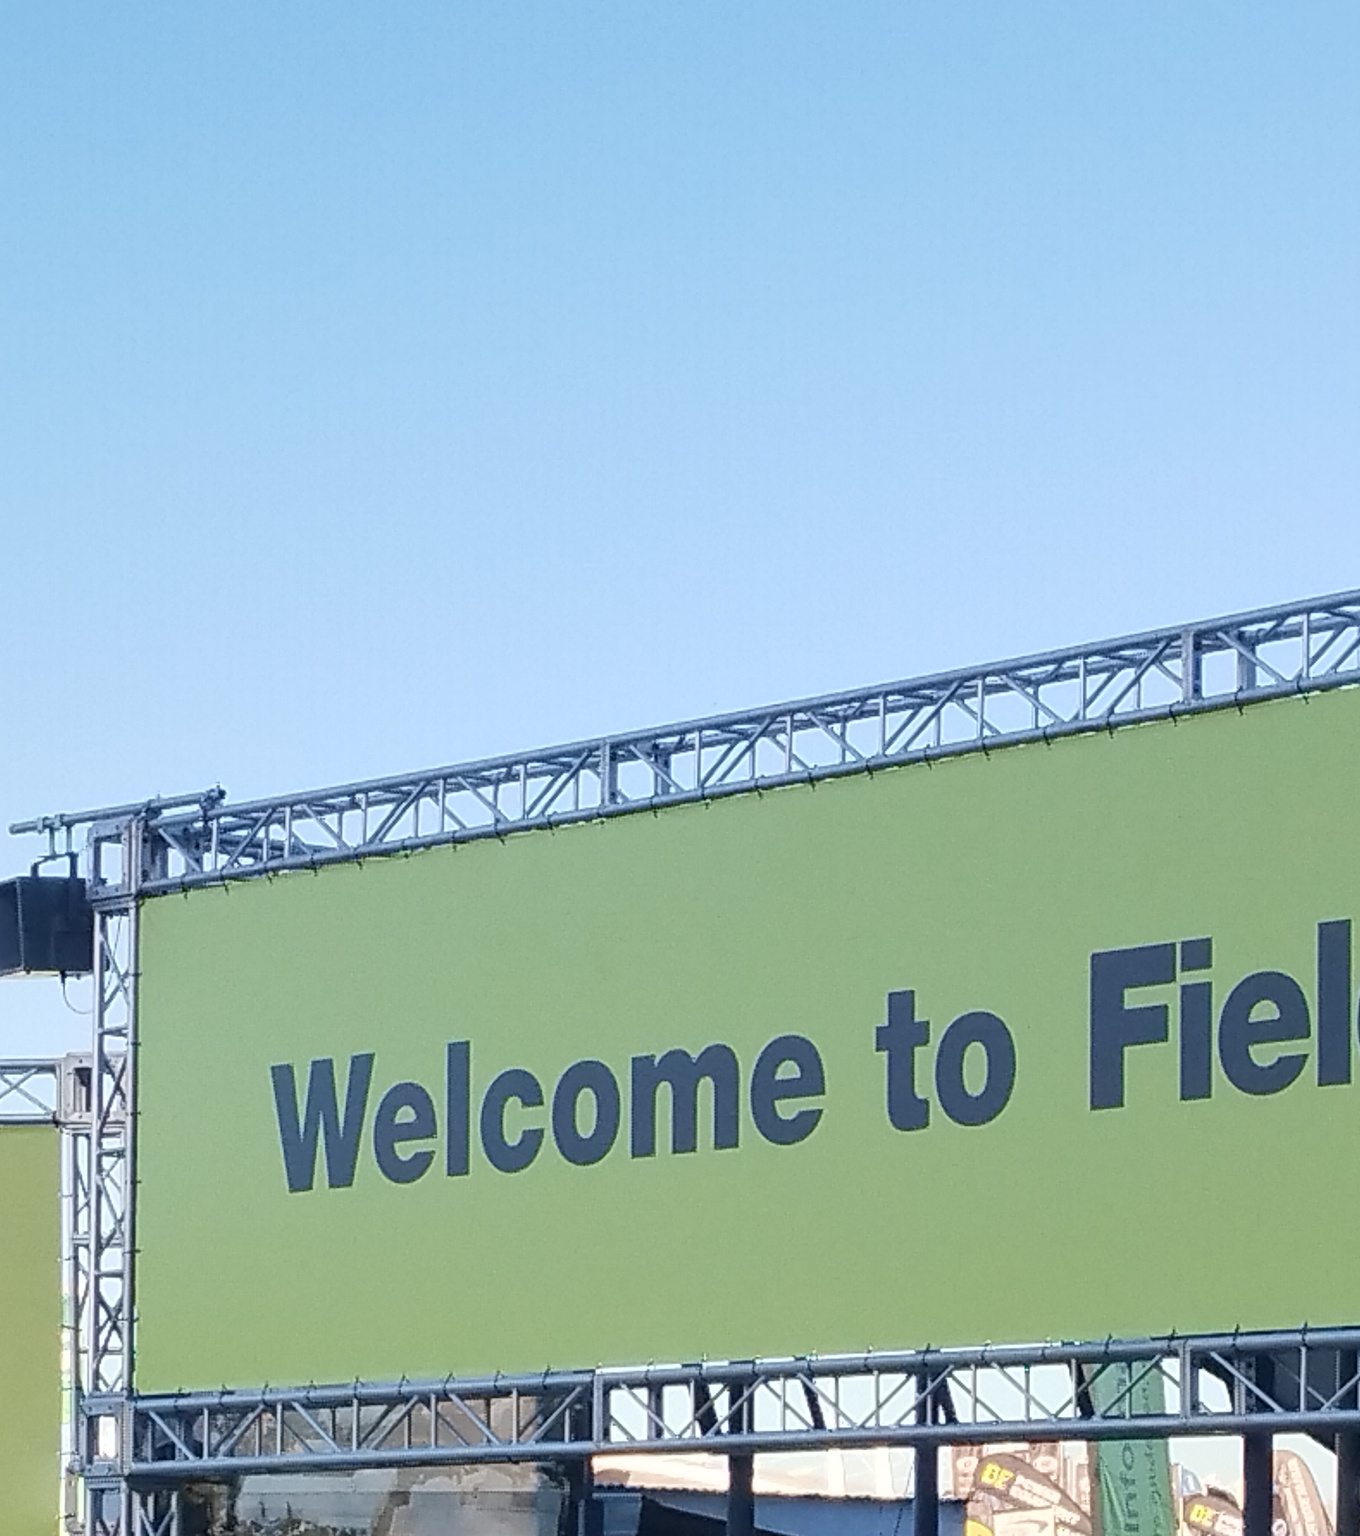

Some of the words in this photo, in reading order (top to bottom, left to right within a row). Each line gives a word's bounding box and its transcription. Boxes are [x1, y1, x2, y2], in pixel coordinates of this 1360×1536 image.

[271, 1036, 827, 1194] Welcome
[875, 990, 1018, 1133] to
[1118, 1443, 1139, 1532] Info
